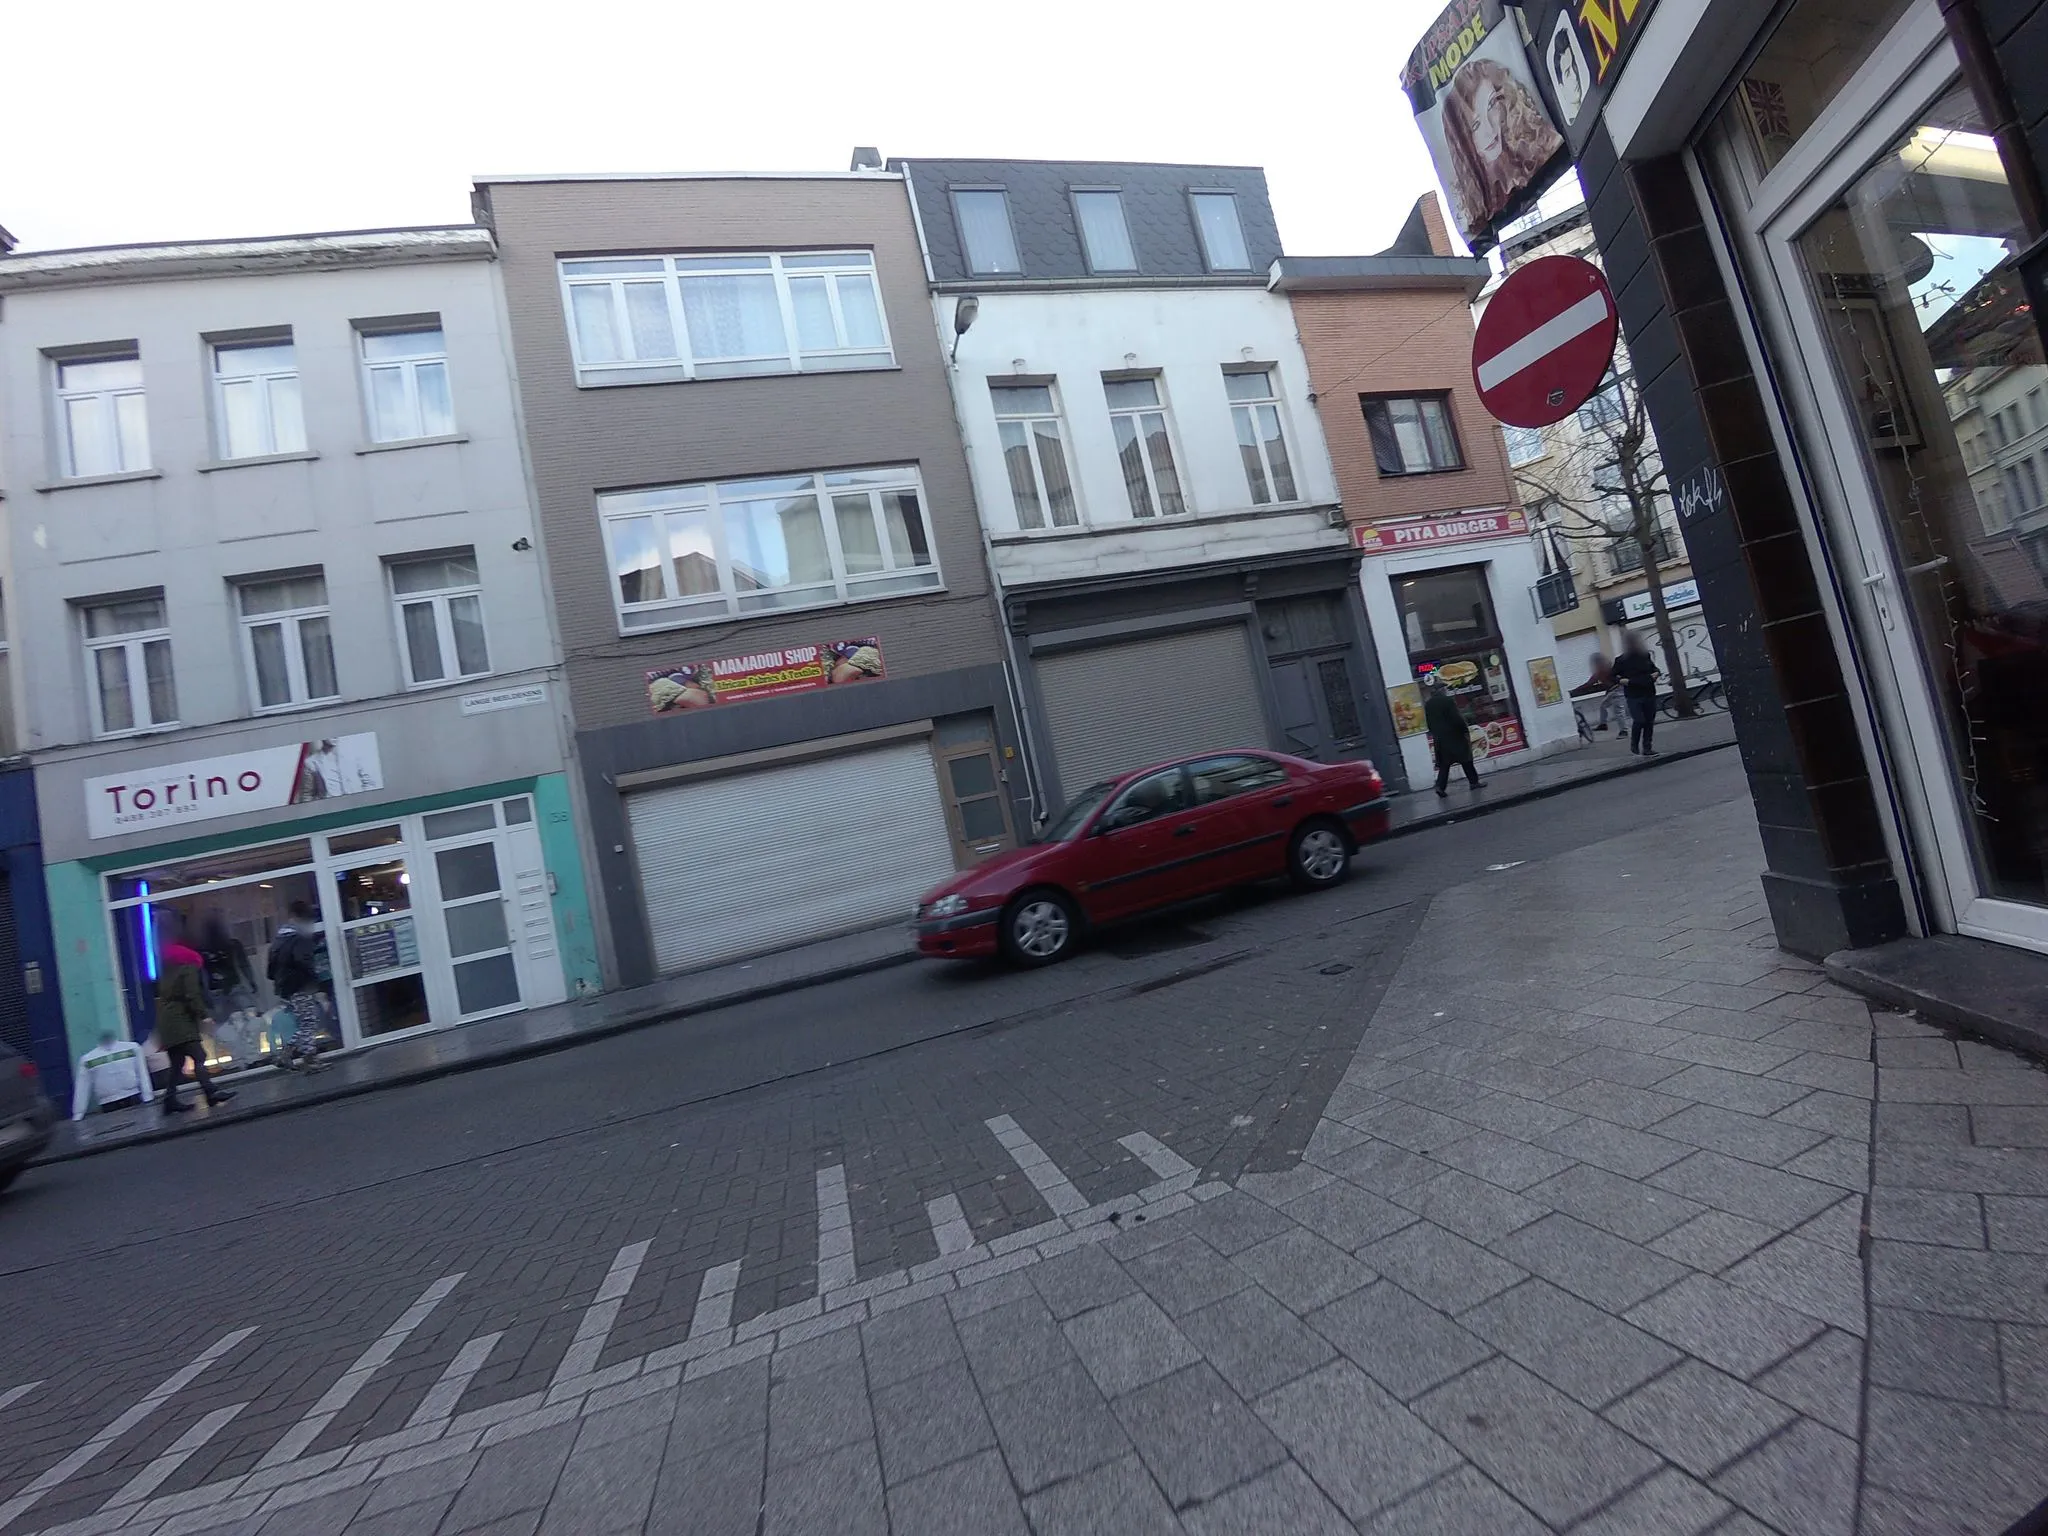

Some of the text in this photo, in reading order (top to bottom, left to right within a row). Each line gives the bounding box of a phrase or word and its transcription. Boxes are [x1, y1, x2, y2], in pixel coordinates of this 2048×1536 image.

[1428, 9, 1487, 90] MODE
[1393, 518, 1499, 543] PITA BURGER
[712, 646, 818, 676] MAMADOU SHOP
[105, 770, 262, 814] Torino
